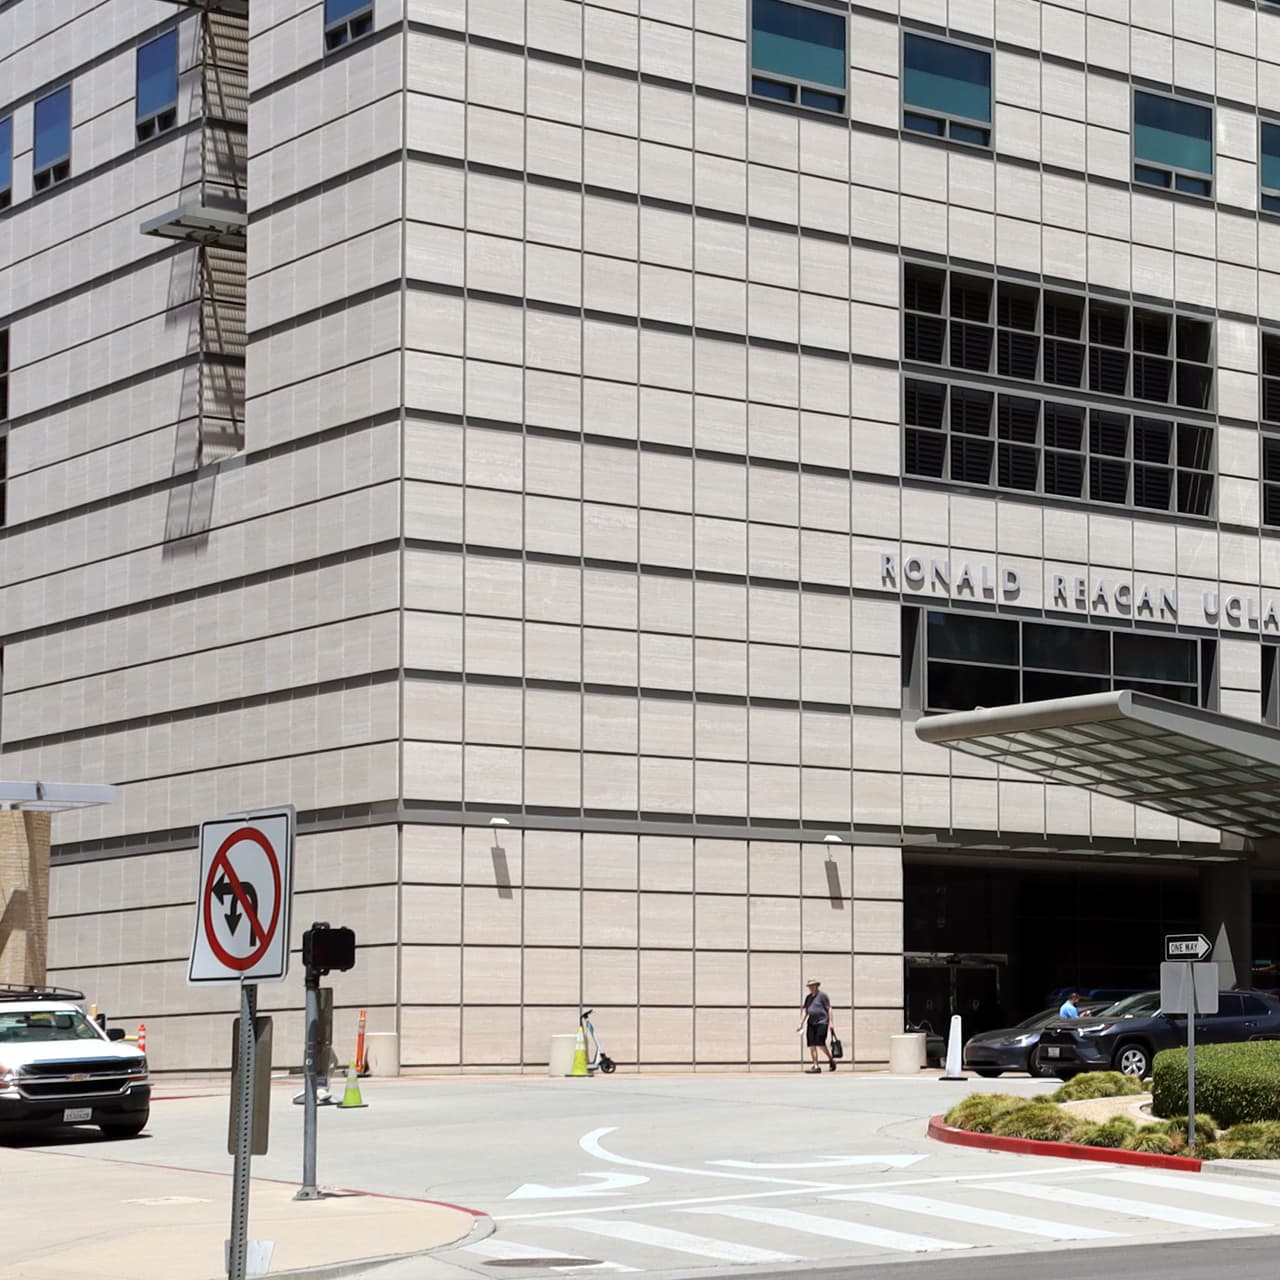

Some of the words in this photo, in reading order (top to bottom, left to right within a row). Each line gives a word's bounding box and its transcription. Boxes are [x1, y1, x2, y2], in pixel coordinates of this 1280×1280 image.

[880, 552, 1022, 596] RONALD
[1053, 574, 1177, 615] REAGAN
[1202, 592, 1280, 628] UCLA
[1170, 943, 1184, 953] ONE
[1185, 942, 1198, 952] WAY
